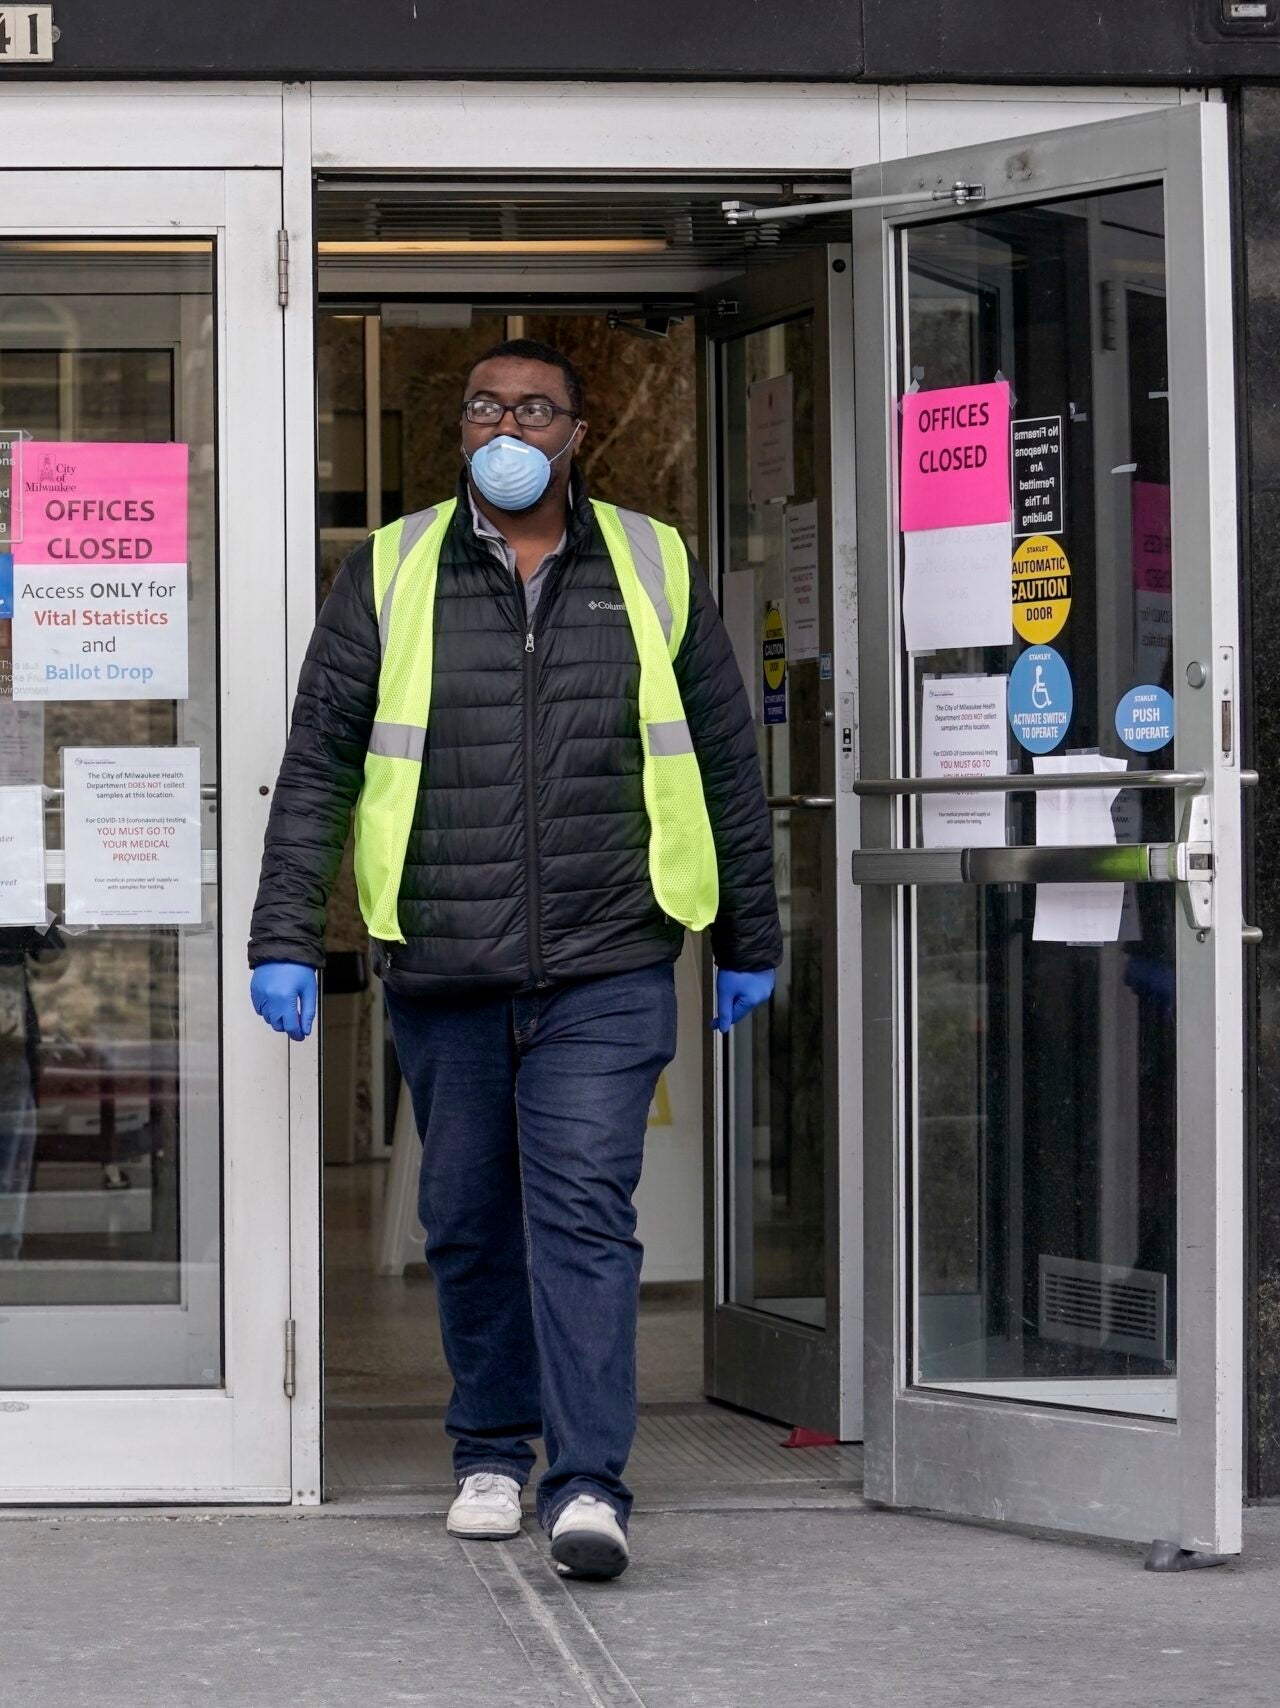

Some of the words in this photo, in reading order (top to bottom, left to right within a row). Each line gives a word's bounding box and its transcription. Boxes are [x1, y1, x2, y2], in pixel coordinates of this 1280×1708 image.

[919, 402, 990, 433] OFFICES
[919, 445, 988, 474] CLOSED
[56, 463, 77, 475] City
[56, 474, 66, 482] of
[24, 482, 77, 492] Milwaukee
[45, 500, 156, 522] OFFICES
[47, 538, 153, 560] CLOSED
[1012, 556, 1066, 576] AUTOMATIC
[22, 584, 84, 599] Access
[90, 582, 144, 598] ONLY
[148, 581, 176, 598] for
[1012, 578, 1068, 600] CAUTION
[34, 610, 76, 626] Vital
[82, 609, 168, 626] Statistics
[1026, 606, 1053, 622] DOOR
[82, 636, 116, 653] and
[1028, 653, 1052, 661] STANLEY
[46, 664, 101, 680] Ballot
[107, 664, 154, 684] Drop
[1134, 694, 1158, 702] STANLEY
[1014, 713, 1042, 725] ACTIVATE
[1043, 712, 1067, 724] SWITCH
[1132, 708, 1160, 722] PUSH
[1022, 727, 1030, 739] TO
[1032, 726, 1058, 738] OPERATE
[1124, 728, 1134, 740] TO
[1136, 726, 1170, 740] OPERATE
[940, 760, 954, 768] YOU
[954, 760, 970, 768] MUST
[972, 760, 982, 768] GO
[982, 760, 991, 768] TO
[102, 772, 114, 780] City
[96, 828, 116, 836] YOU
[162, 827, 176, 835] TO
[102, 840, 128, 848] YOUR
[130, 840, 170, 848] MEDICAL
[112, 853, 160, 862] PROVIDER.
